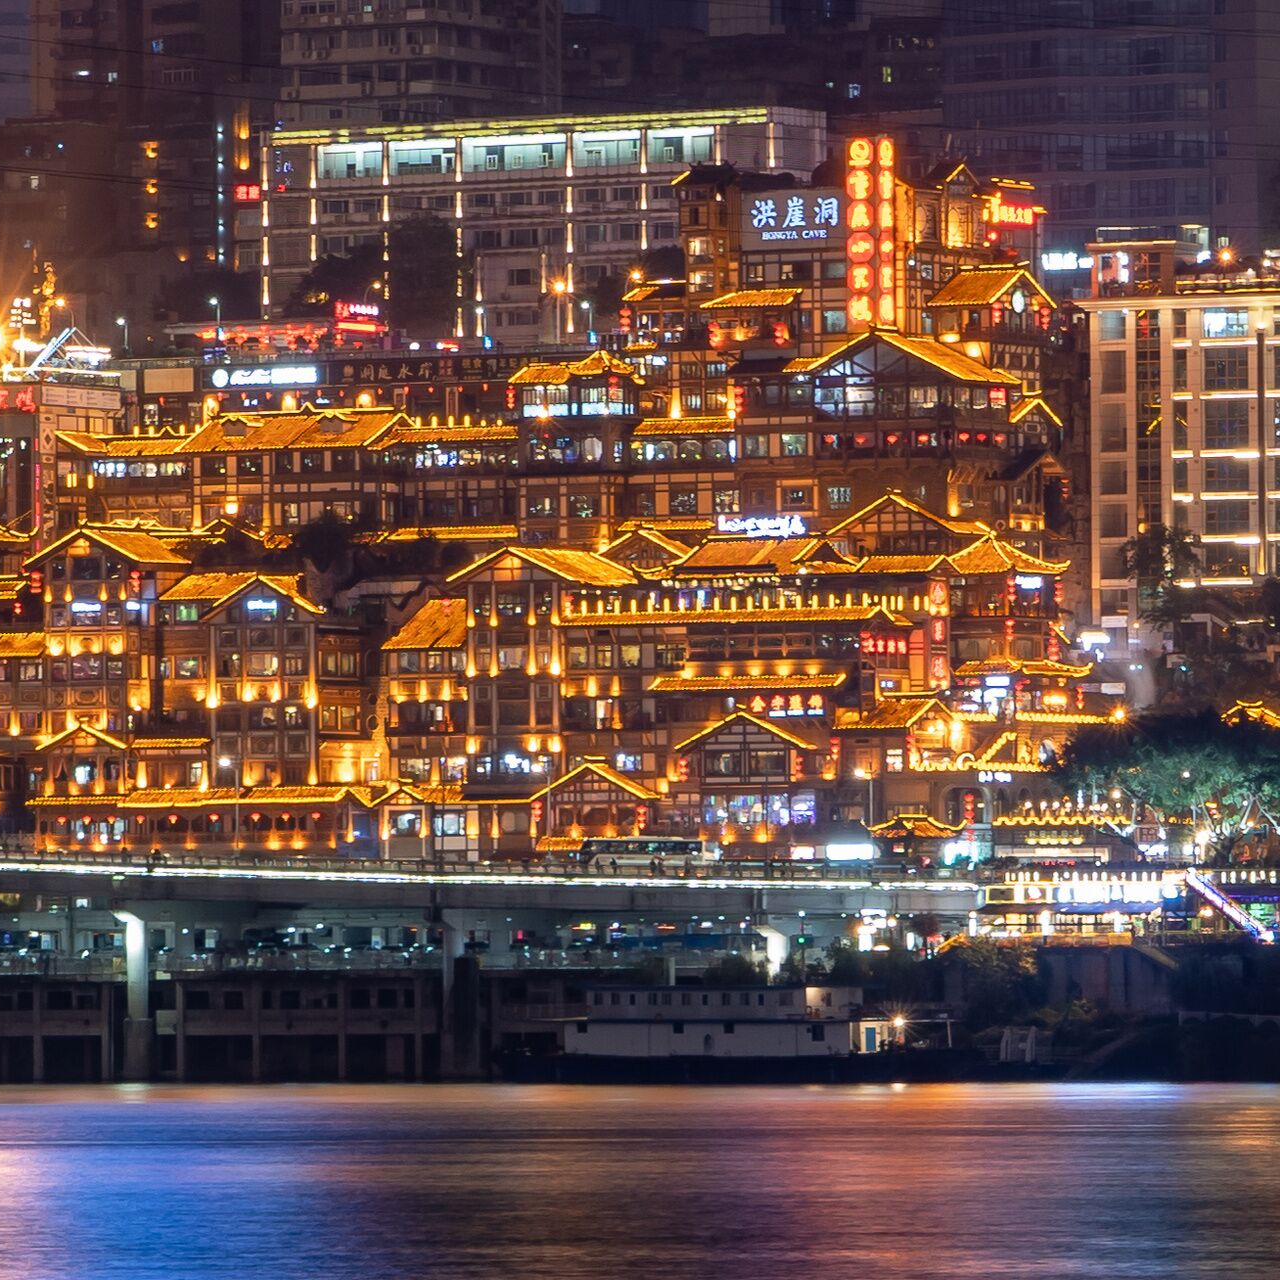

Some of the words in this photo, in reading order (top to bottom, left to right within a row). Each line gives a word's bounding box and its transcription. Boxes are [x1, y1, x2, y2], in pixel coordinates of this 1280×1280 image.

[751, 196, 839, 229] 洪崖洞
[801, 230, 827, 239] CAVE
